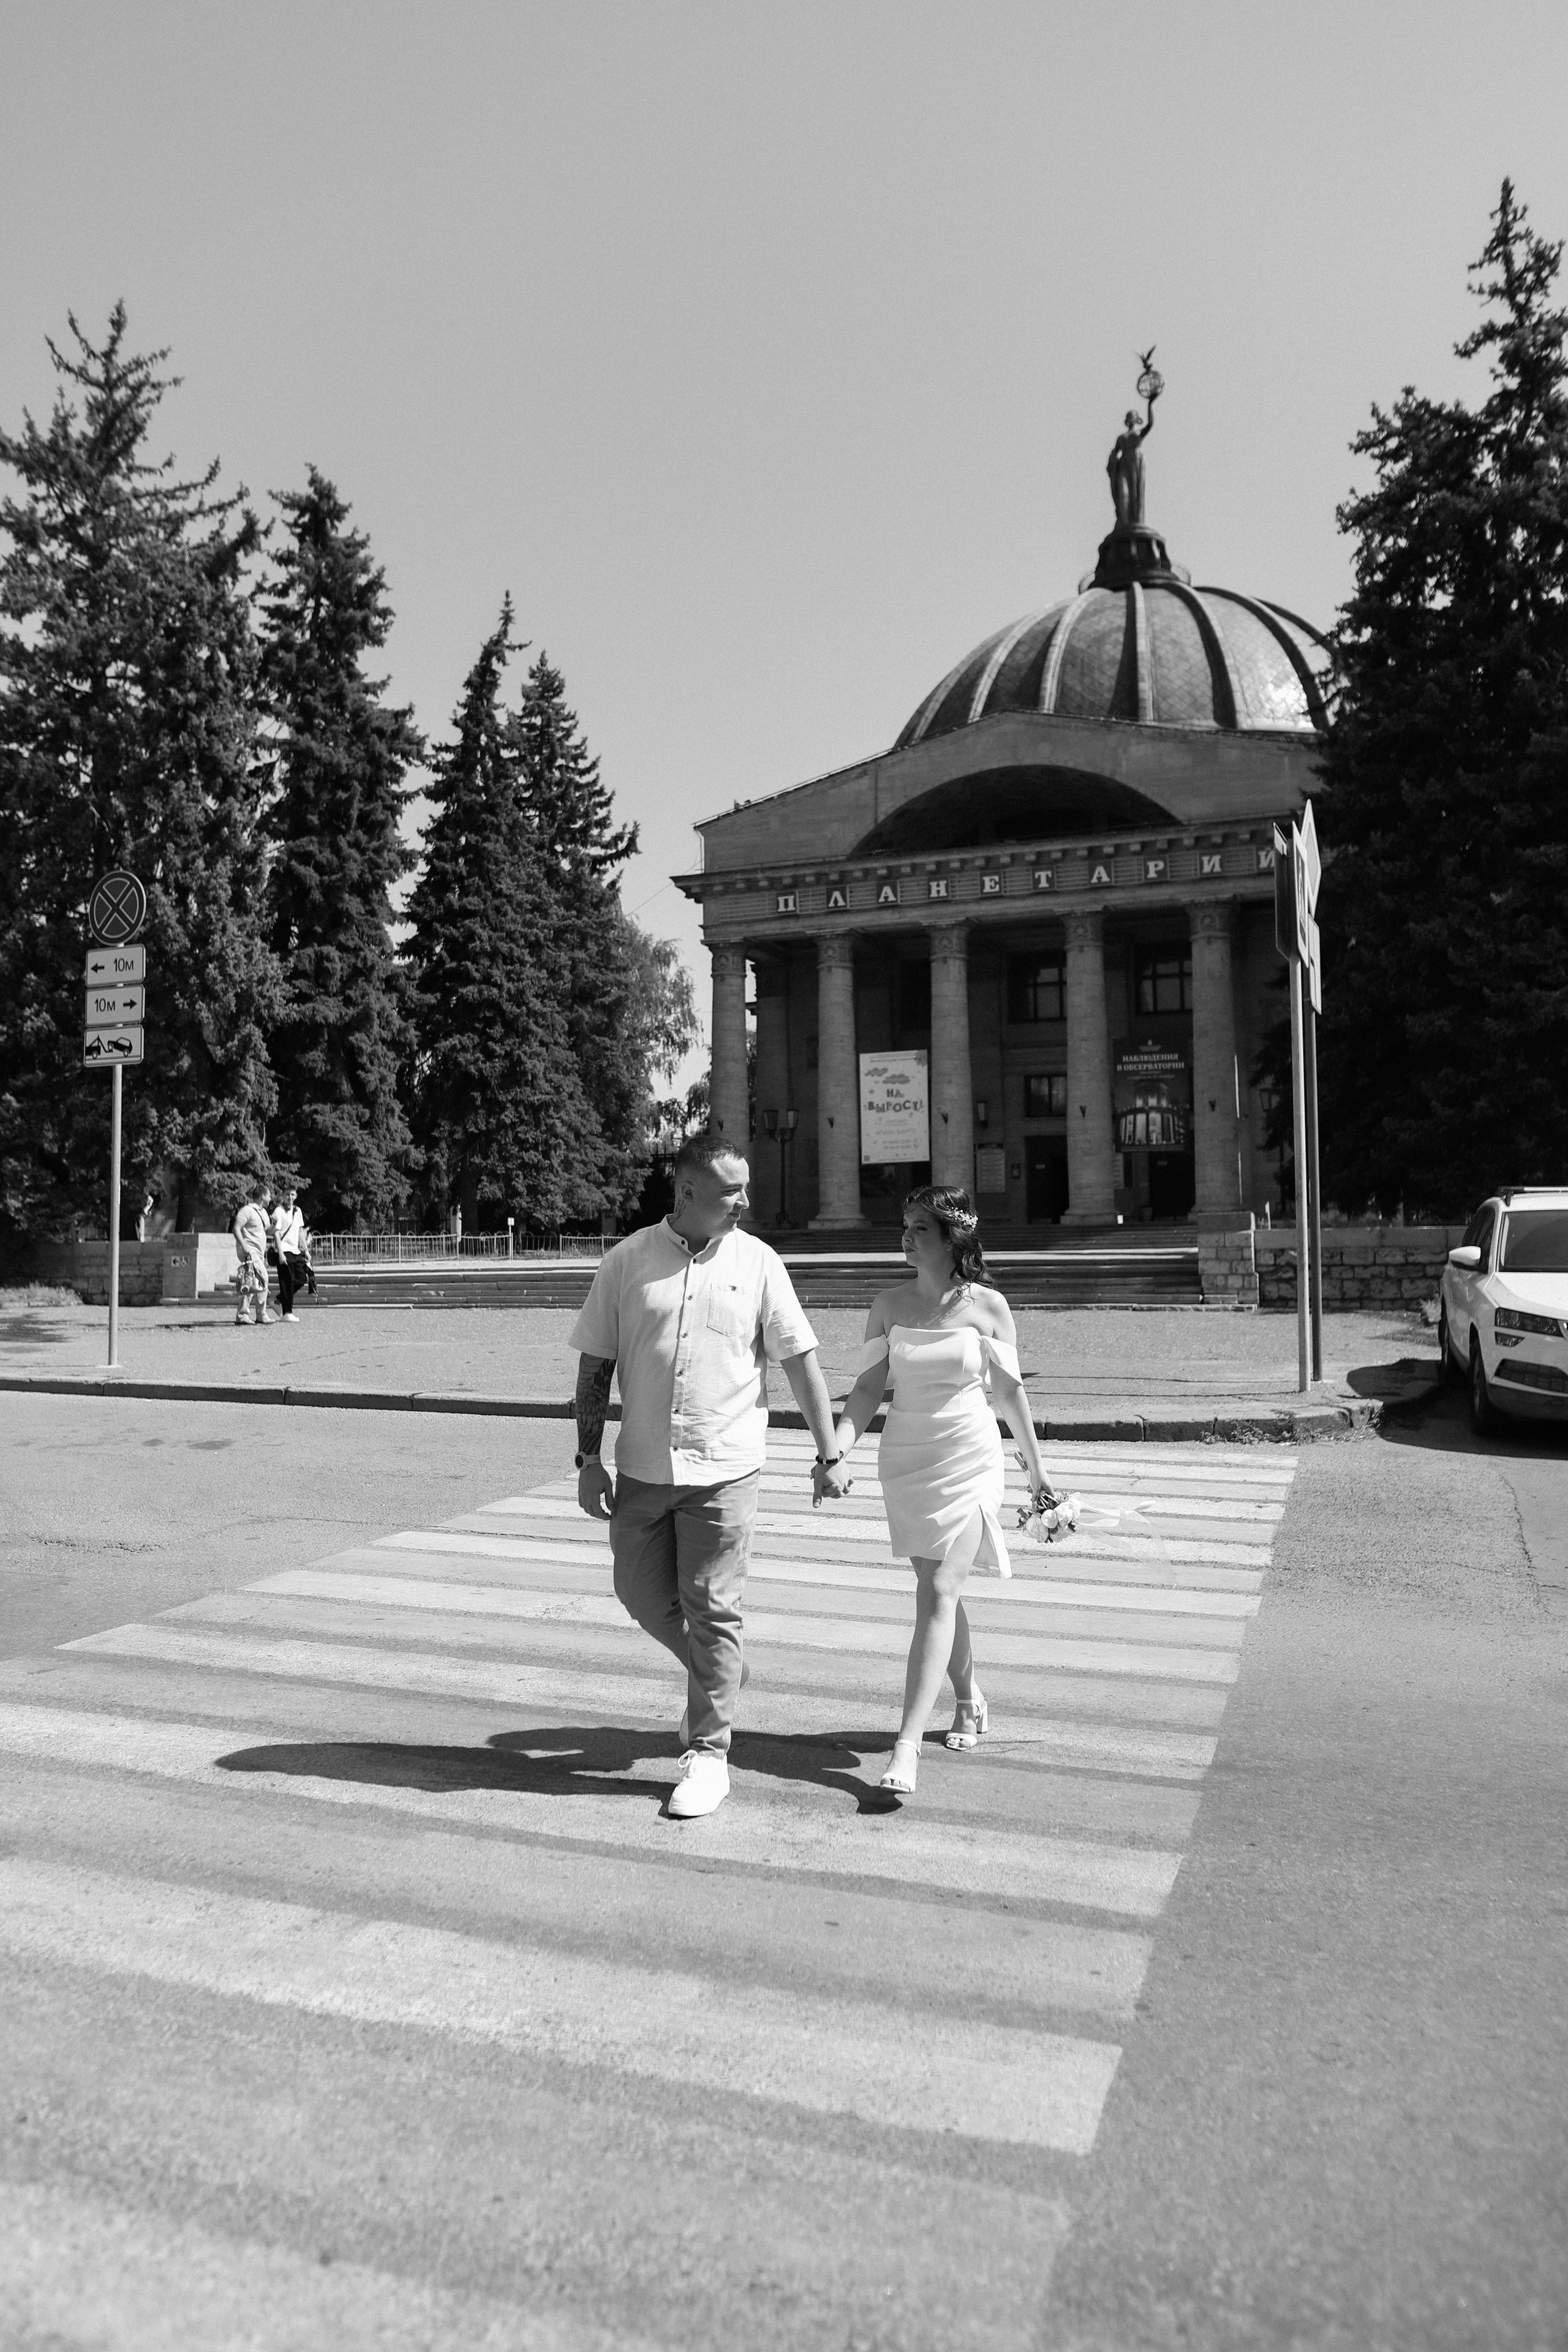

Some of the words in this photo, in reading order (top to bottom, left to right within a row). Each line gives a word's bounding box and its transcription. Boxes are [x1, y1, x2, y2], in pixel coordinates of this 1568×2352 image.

[777, 846, 1275, 912] ПЛАНЕТАРИЙ
[1122, 1053, 1178, 1063] НАБЛЮДЕНИЯ
[1123, 1061, 1185, 1071] ОБСЕРВАТОРИИ
[887, 1088, 903, 1098] НА
